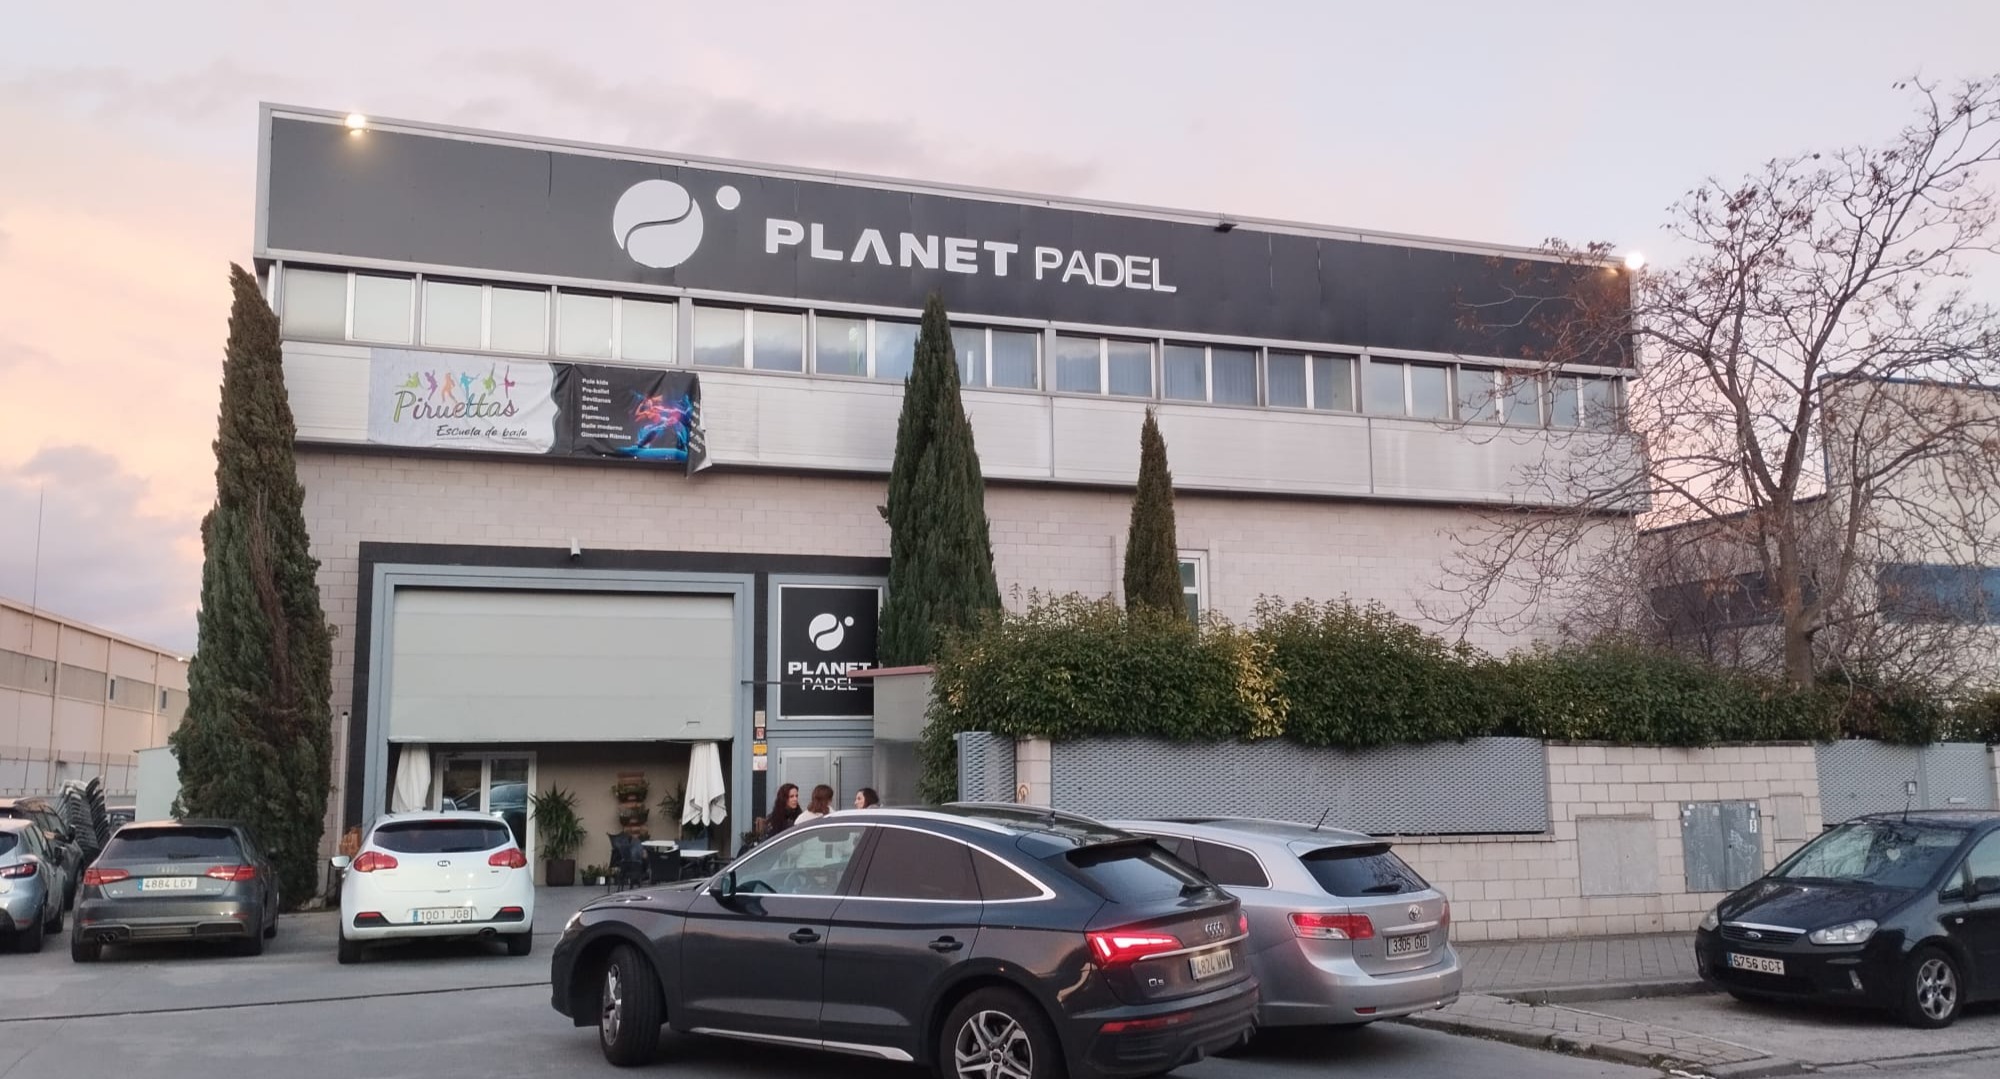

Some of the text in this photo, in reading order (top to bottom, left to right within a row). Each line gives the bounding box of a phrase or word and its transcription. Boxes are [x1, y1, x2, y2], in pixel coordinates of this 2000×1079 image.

[766, 218, 1177, 293] PLANET PADEL
[582, 395, 612, 404] Sevillanas
[393, 390, 519, 423] Piruettas
[581, 404, 599, 412] Ballet
[581, 413, 610, 421] Flamenco
[436, 424, 481, 437] Escuela
[484, 426, 497, 437] de
[581, 431, 609, 439] Gimnasia
[802, 677, 858, 691] PADEL
[144, 878, 194, 889] 4884 LGY
[421, 909, 469, 920] 1001 JGB
[1393, 937, 1411, 953] 3305
[1733, 954, 1782, 973] 6756 GCT
